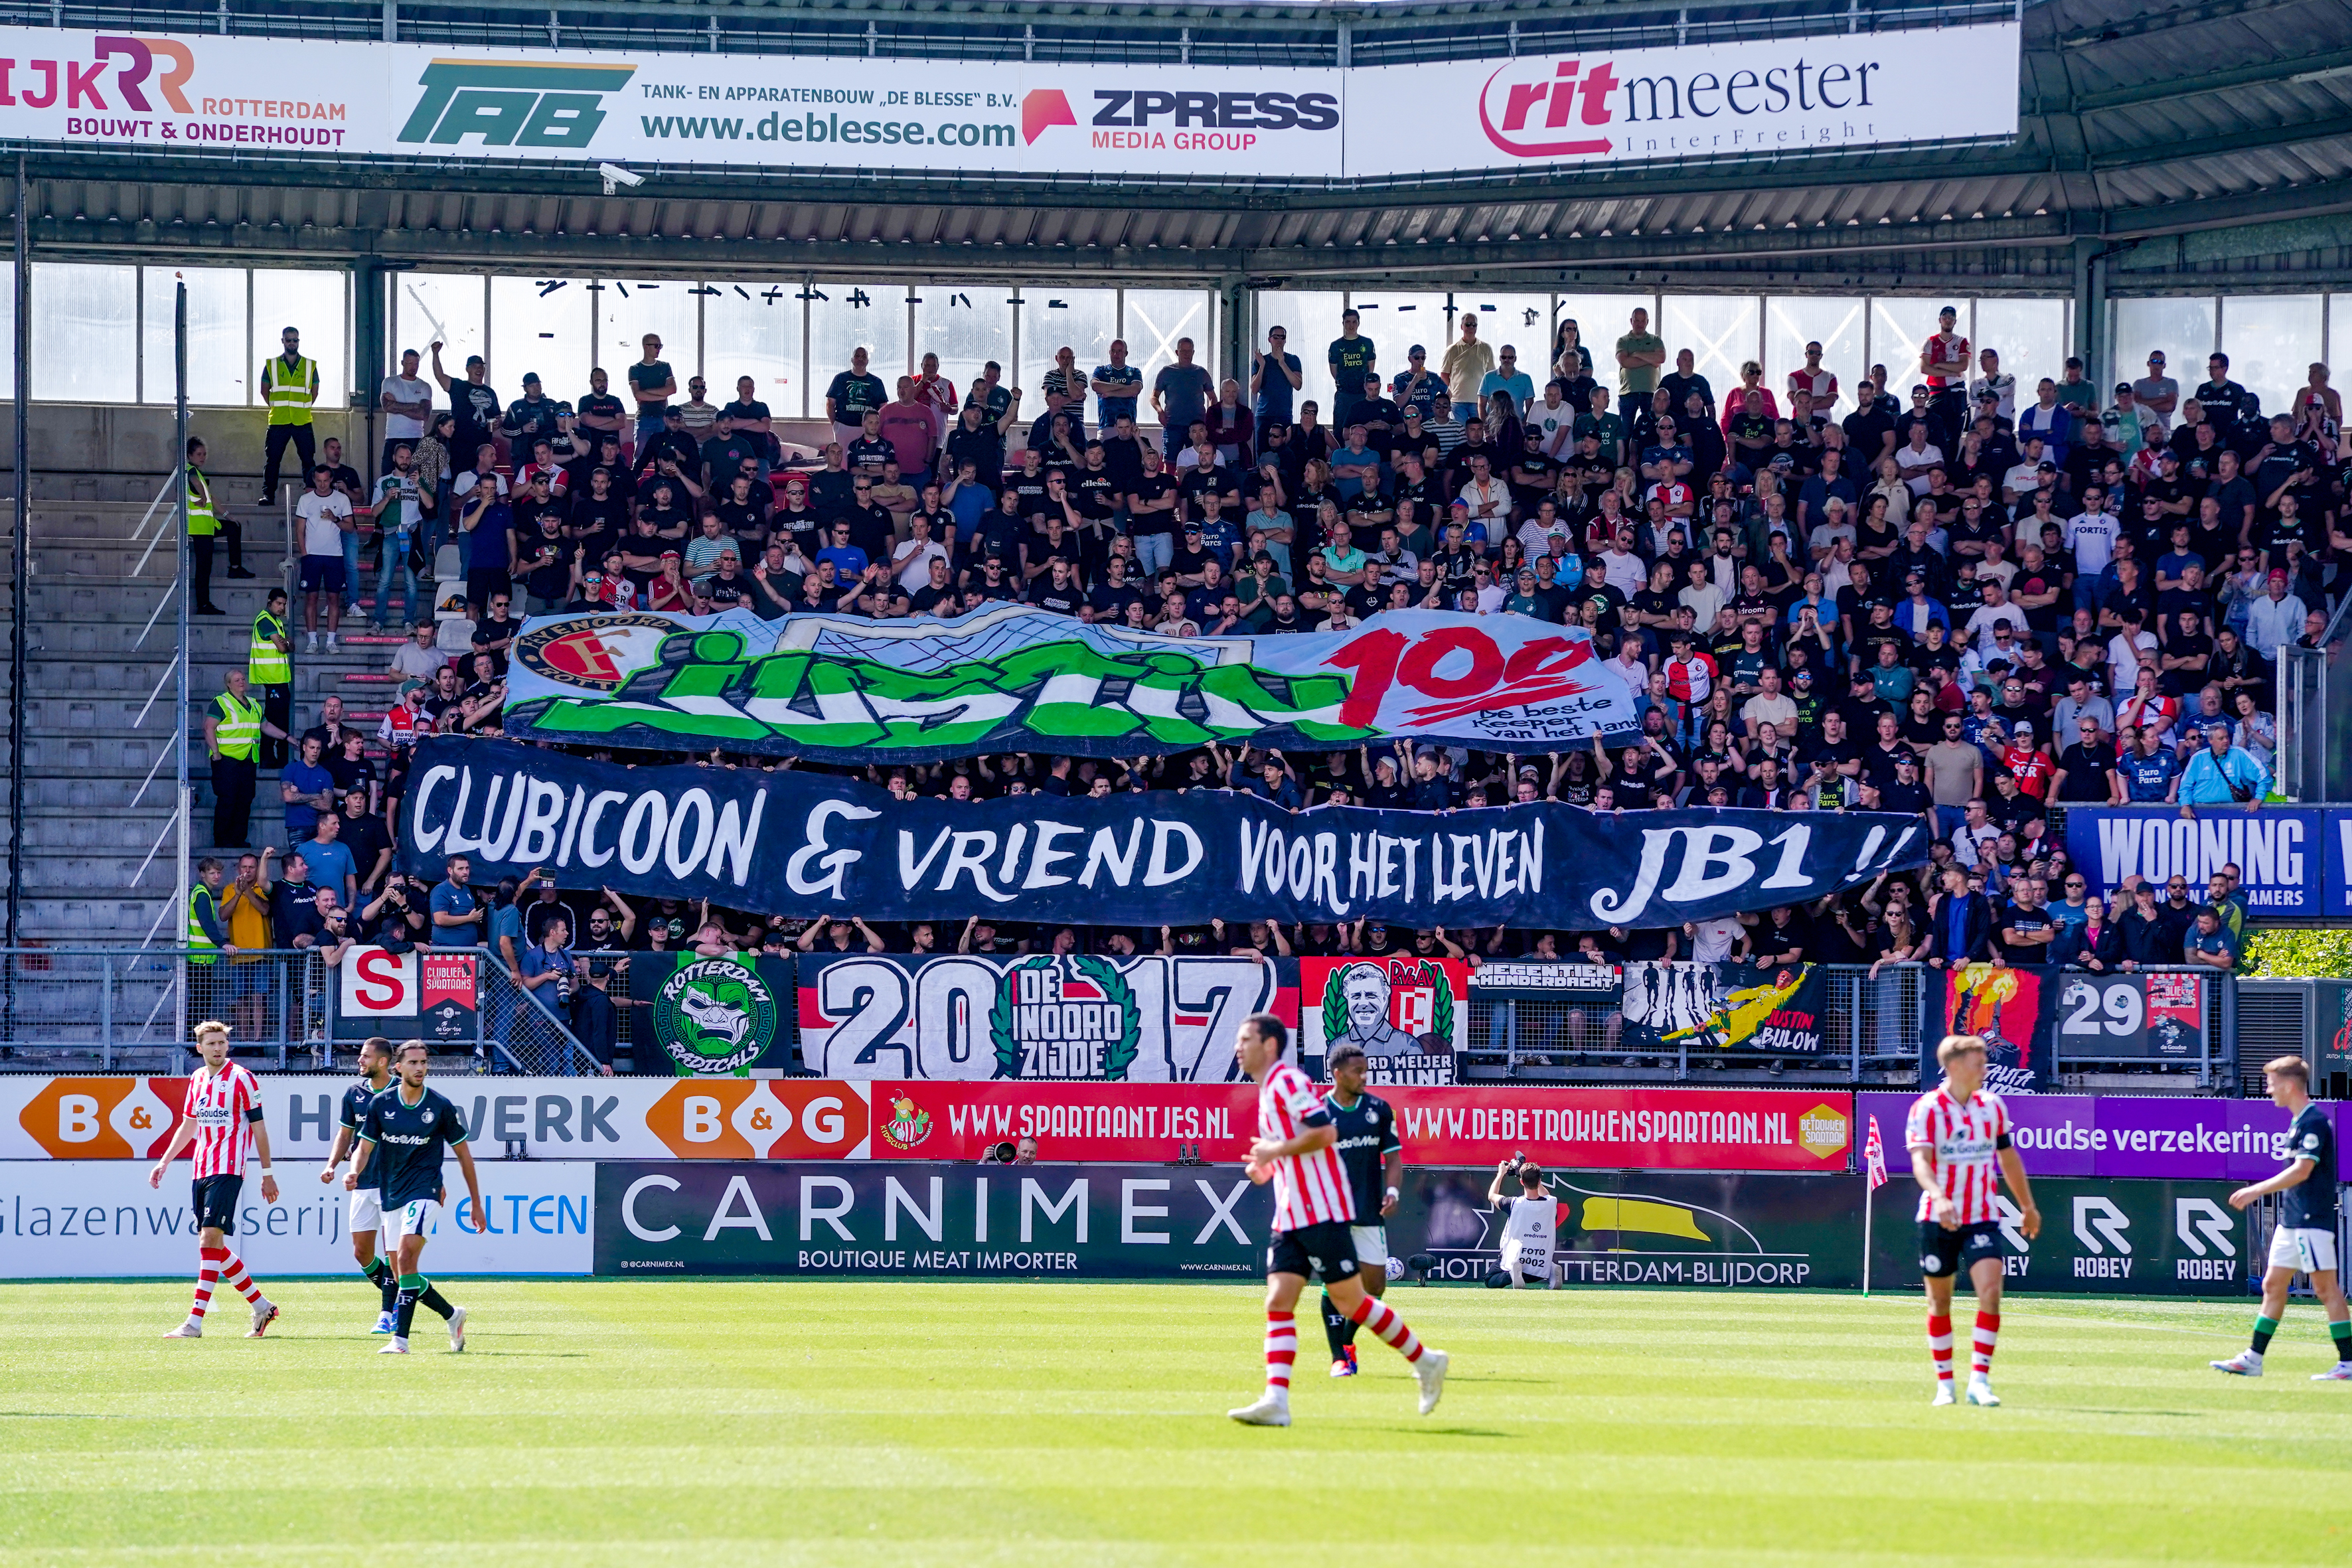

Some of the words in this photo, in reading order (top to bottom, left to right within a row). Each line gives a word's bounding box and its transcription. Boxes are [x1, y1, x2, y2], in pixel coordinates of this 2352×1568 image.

[397, 57, 639, 148] TAB
[641, 84, 693, 99] TANK-
[698, 86, 720, 100] EN
[726, 87, 874, 105] APPARATENBOUW
[986, 93, 1018, 109] B.V.
[1502, 57, 1880, 131] ritmeester
[202, 97, 346, 121] ROTTERDAM
[1092, 90, 1340, 130] ZPRESS
[67, 117, 153, 139] BOUWT
[161, 121, 179, 141] &
[187, 122, 346, 147] ONDERHOUDT
[641, 111, 1016, 147] www.deblesse.com
[1093, 131, 1166, 150] MEDIA
[1174, 133, 1257, 151] GROUP
[1626, 121, 1876, 153] InterFreight
[605, 591, 627, 604] ASR
[520, 615, 672, 649] FEYENOORD
[1523, 696, 1612, 719] beste
[1472, 716, 1583, 732] Keeper
[1483, 728, 1534, 740] van
[1544, 724, 1585, 739] het
[1591, 713, 1642, 734] land
[2011, 765, 2038, 777] ASR
[412, 764, 767, 887] CLUBICOON
[786, 799, 882, 901] &
[899, 817, 1204, 903] VRIEND
[1239, 817, 1350, 916] VOOR
[1350, 828, 1421, 903] HET
[1432, 817, 1545, 904] LEVEN
[1593, 823, 1814, 923] JB1
[1846, 824, 1918, 882] !!
[2098, 819, 2304, 886] WOONING
[355, 950, 403, 1010] S
[663, 959, 771, 1003] ROTTERDAM
[1476, 963, 1615, 979] NEGENTIEN
[1480, 975, 1614, 990] HONDERDACHT
[426, 979, 471, 990] SPARTAANS
[1020, 969, 1059, 1004] DE
[1013, 1004, 1123, 1041] NOORD
[1767, 1008, 1816, 1030] JUSTIN
[2061, 983, 2144, 1036] 29
[1761, 1027, 1819, 1052] BIJLOW
[666, 1040, 760, 1075] RADICALS
[1020, 1041, 1107, 1076] ZIJDE
[1394, 1055, 1452, 1069] MEIJER
[59, 1094, 99, 1142] B
[129, 1107, 152, 1129] &
[683, 1095, 722, 1142] B
[750, 1107, 773, 1131] &
[801, 1097, 845, 1143] G
[948, 1104, 1235, 1140] WWW.SPARTAANTJES.NL
[1403, 1107, 1792, 1145] WWW.DEBETROKKENSPARTAAN.NL
[1801, 1119, 1845, 1131] BETROKKEN
[880, 1125, 909, 1151] KIDSCLUB
[916, 1122, 934, 1146] SPARTAANTJES
[1805, 1131, 1845, 1144] SPARTAAN
[408, 1202, 417, 1217] 6
[621, 1174, 1252, 1245] CARNIMEX
[799, 1250, 904, 1271] BOUTIQUE
[913, 1251, 970, 1269] MEAT
[977, 1251, 1078, 1270] IMPORTER
[1519, 1257, 1545, 1269] 9002
[1522, 1247, 1546, 1257] FOTO
[2074, 1257, 2133, 1279] ROBEY
[2177, 1259, 2236, 1282] ROBEY
